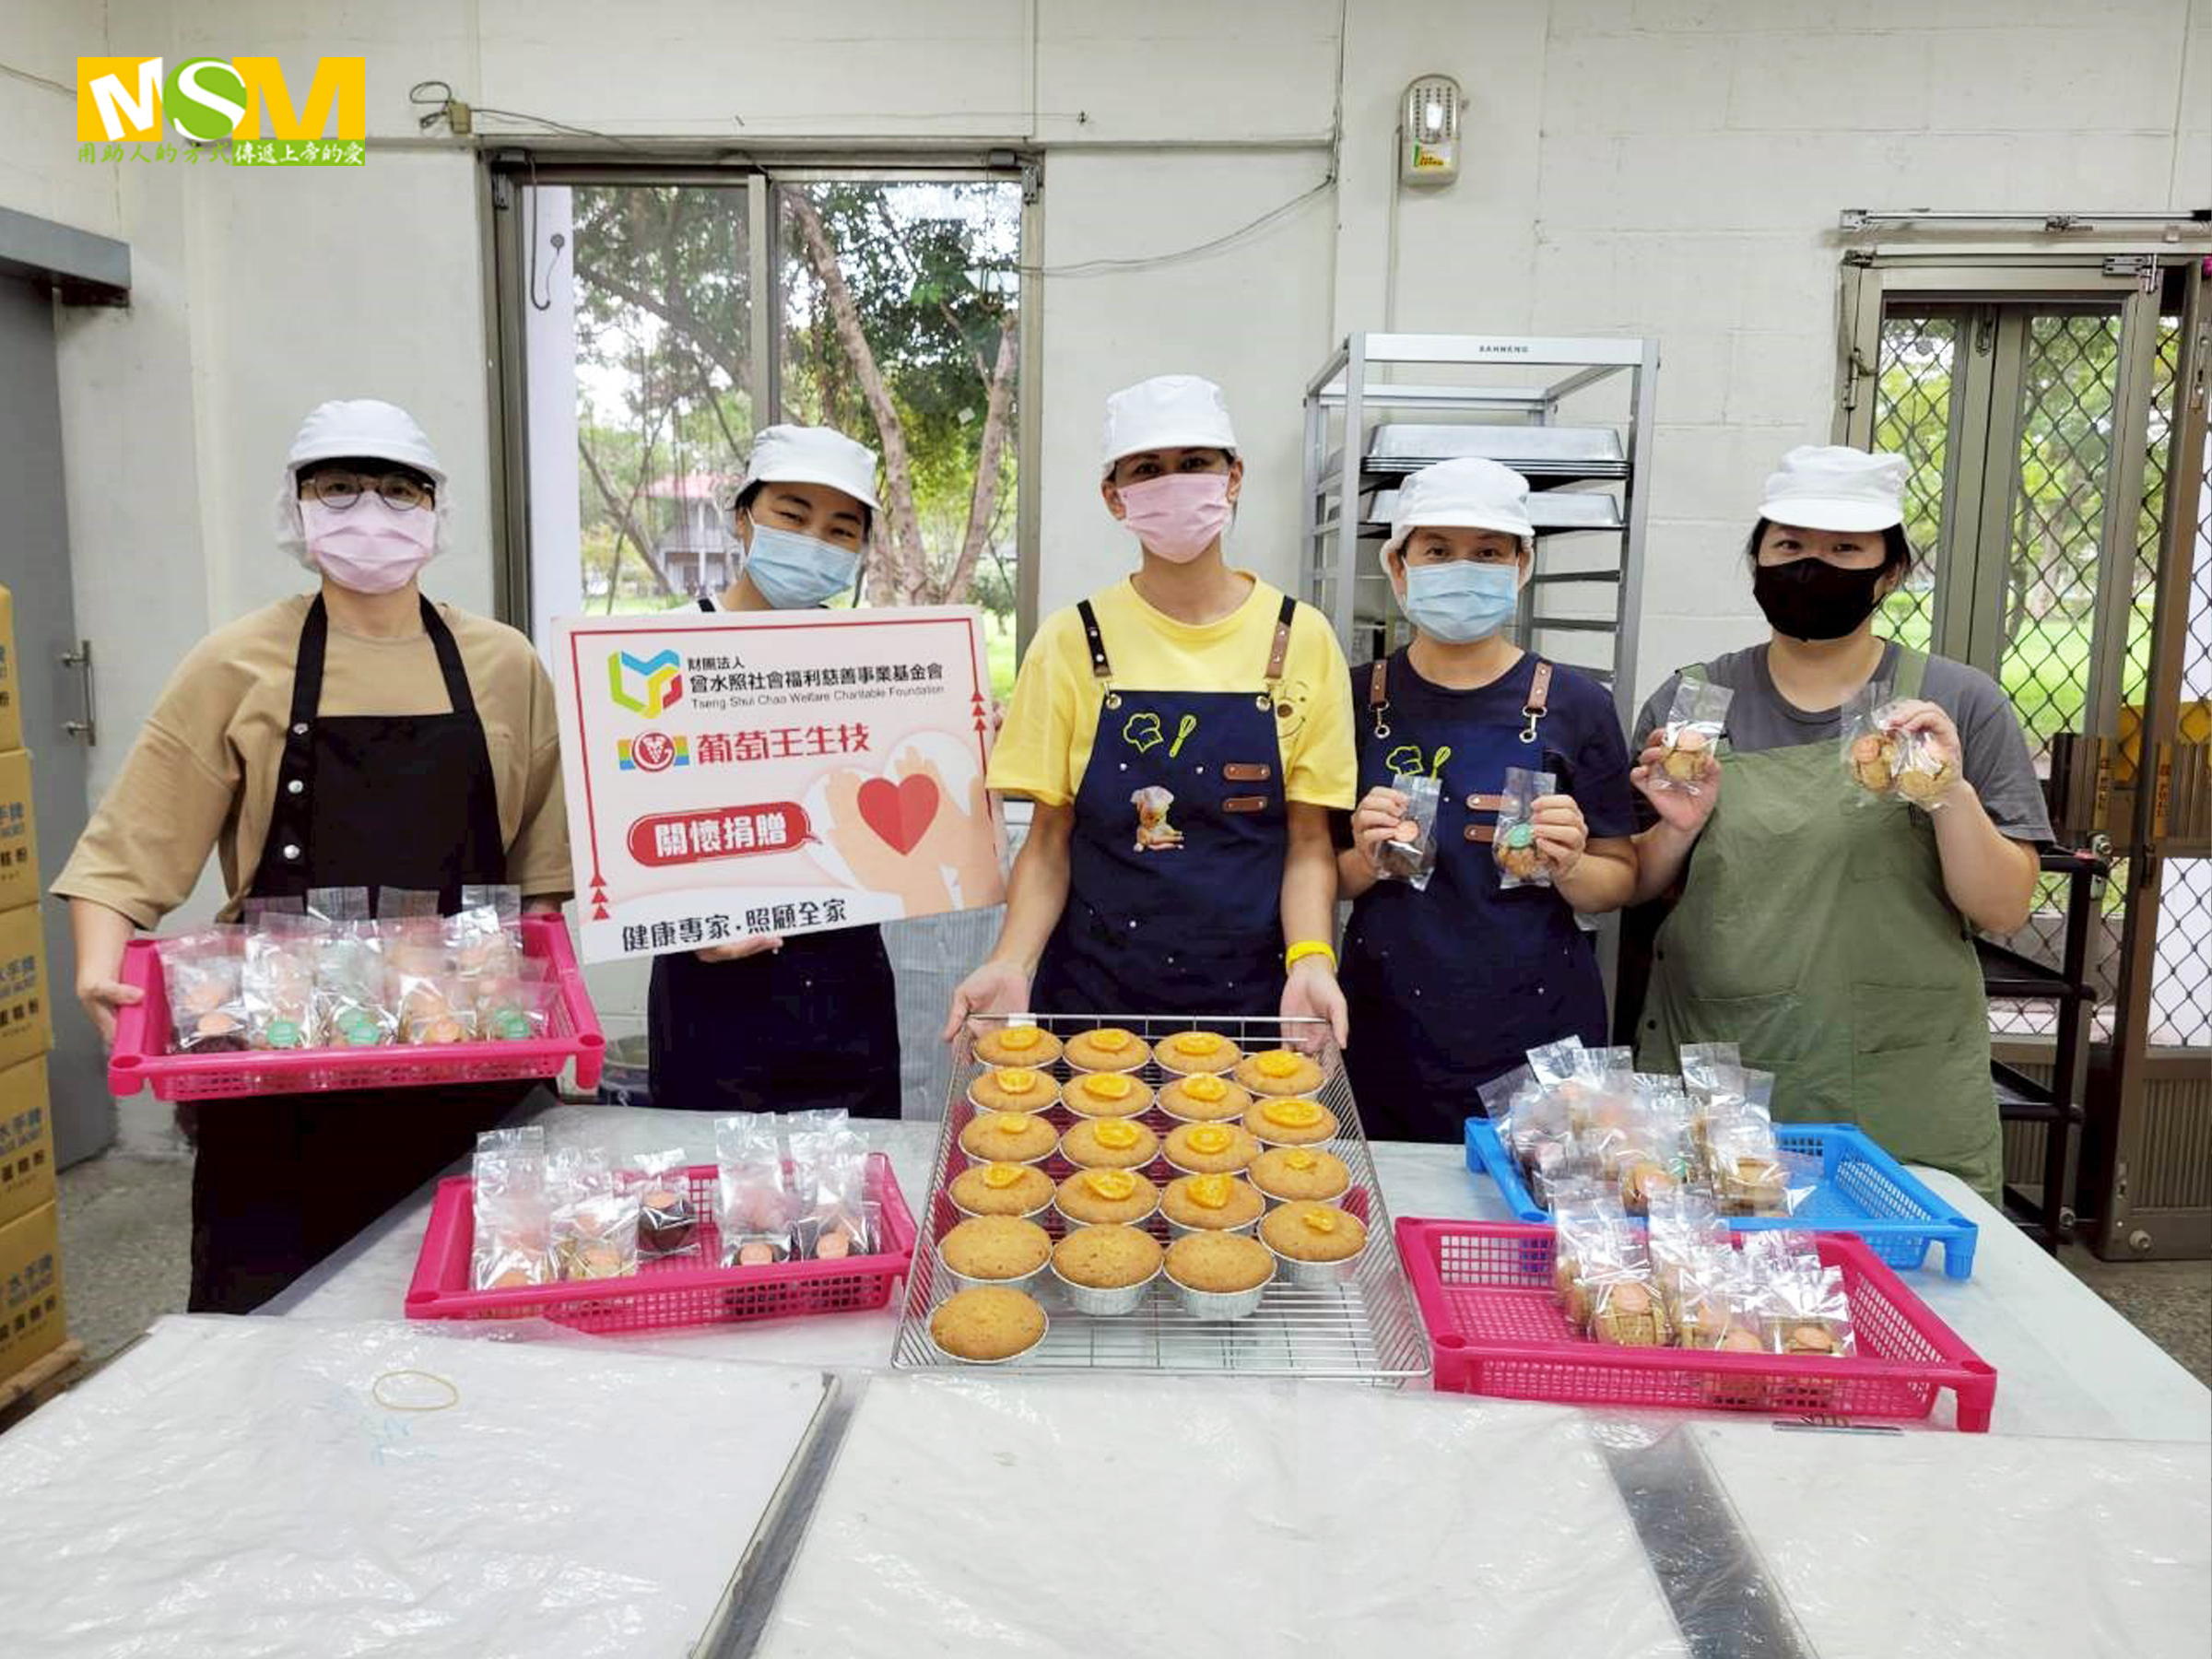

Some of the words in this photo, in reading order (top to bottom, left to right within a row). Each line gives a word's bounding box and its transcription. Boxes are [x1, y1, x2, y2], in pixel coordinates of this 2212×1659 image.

[688, 656, 746, 673] 財團法人
[690, 663, 943, 694] 曾水照社會福利慈善事業基金會
[691, 699, 725, 711] Tseng
[730, 696, 755, 707] Shui
[758, 693, 786, 705] Chao
[790, 691, 830, 703] Welfare
[833, 688, 885, 700] Charitable
[888, 685, 945, 698] Foundation
[697, 723, 871, 764] 葡萄王生技
[654, 812, 787, 857] 關懷捐贈
